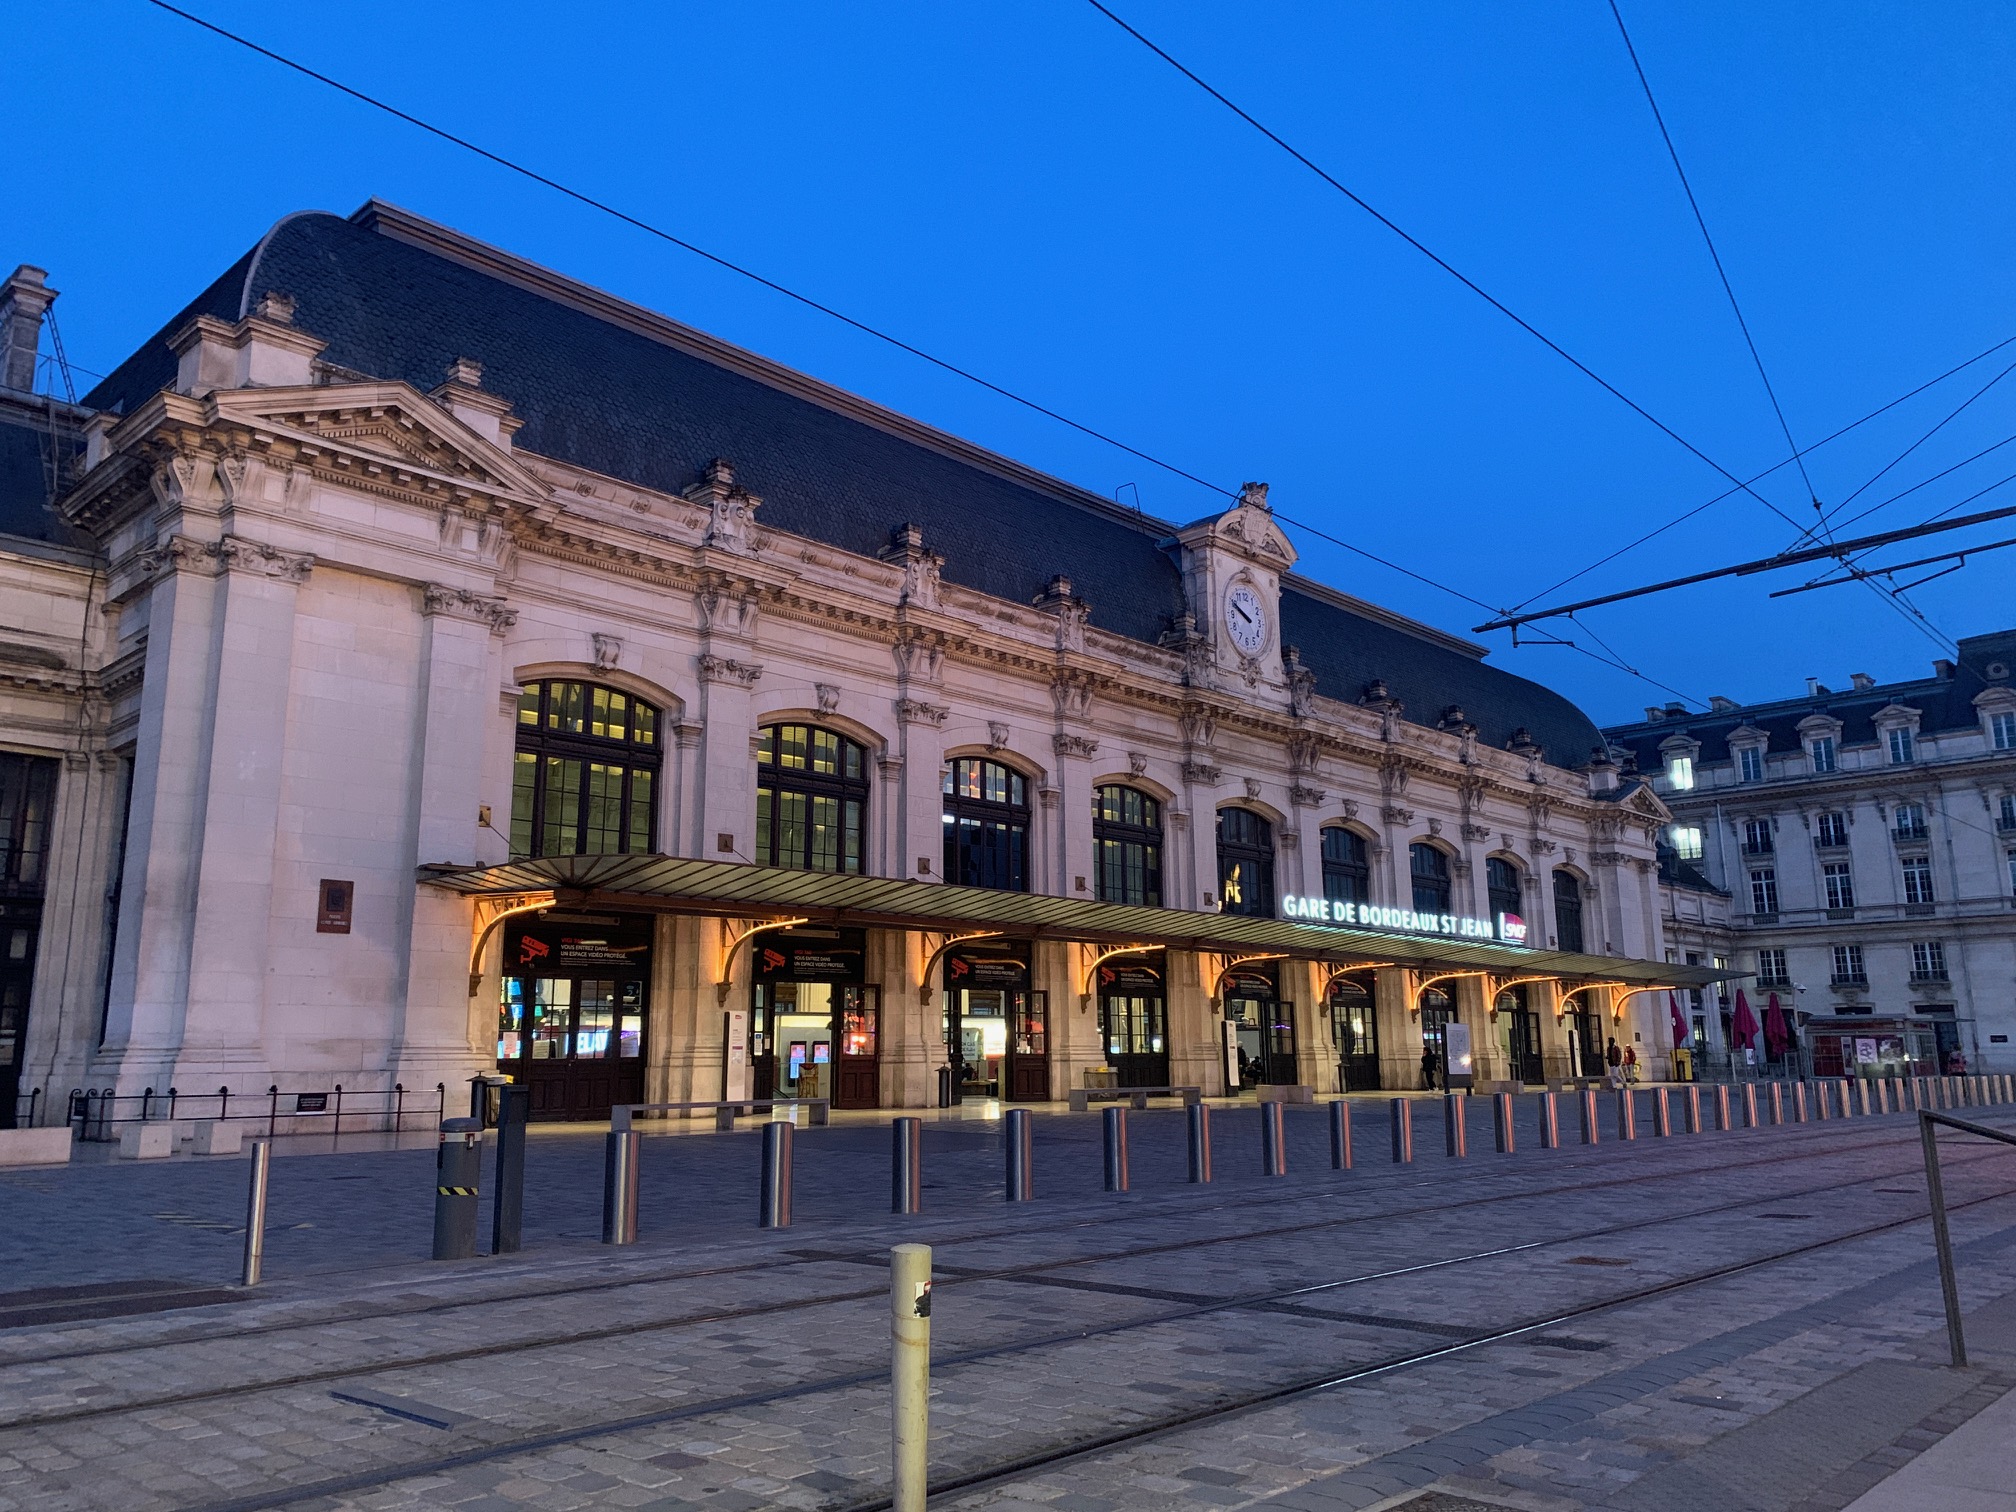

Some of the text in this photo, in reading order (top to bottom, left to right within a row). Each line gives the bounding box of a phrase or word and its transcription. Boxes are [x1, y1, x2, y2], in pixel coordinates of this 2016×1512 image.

[1236, 592, 1241, 601] 11
[1242, 593, 1248, 602] 12
[1231, 609, 1235, 619] 9
[1255, 607, 1259, 616] 2
[1232, 621, 1237, 631] 8
[1258, 619, 1261, 628] 3
[1238, 631, 1242, 641] 7
[1252, 636, 1256, 646] 5
[1245, 637, 1249, 646] 6
[1283, 895, 1493, 938] GARE DE BORDEAUX ST JEAN
[1504, 923, 1527, 939] SNCF
